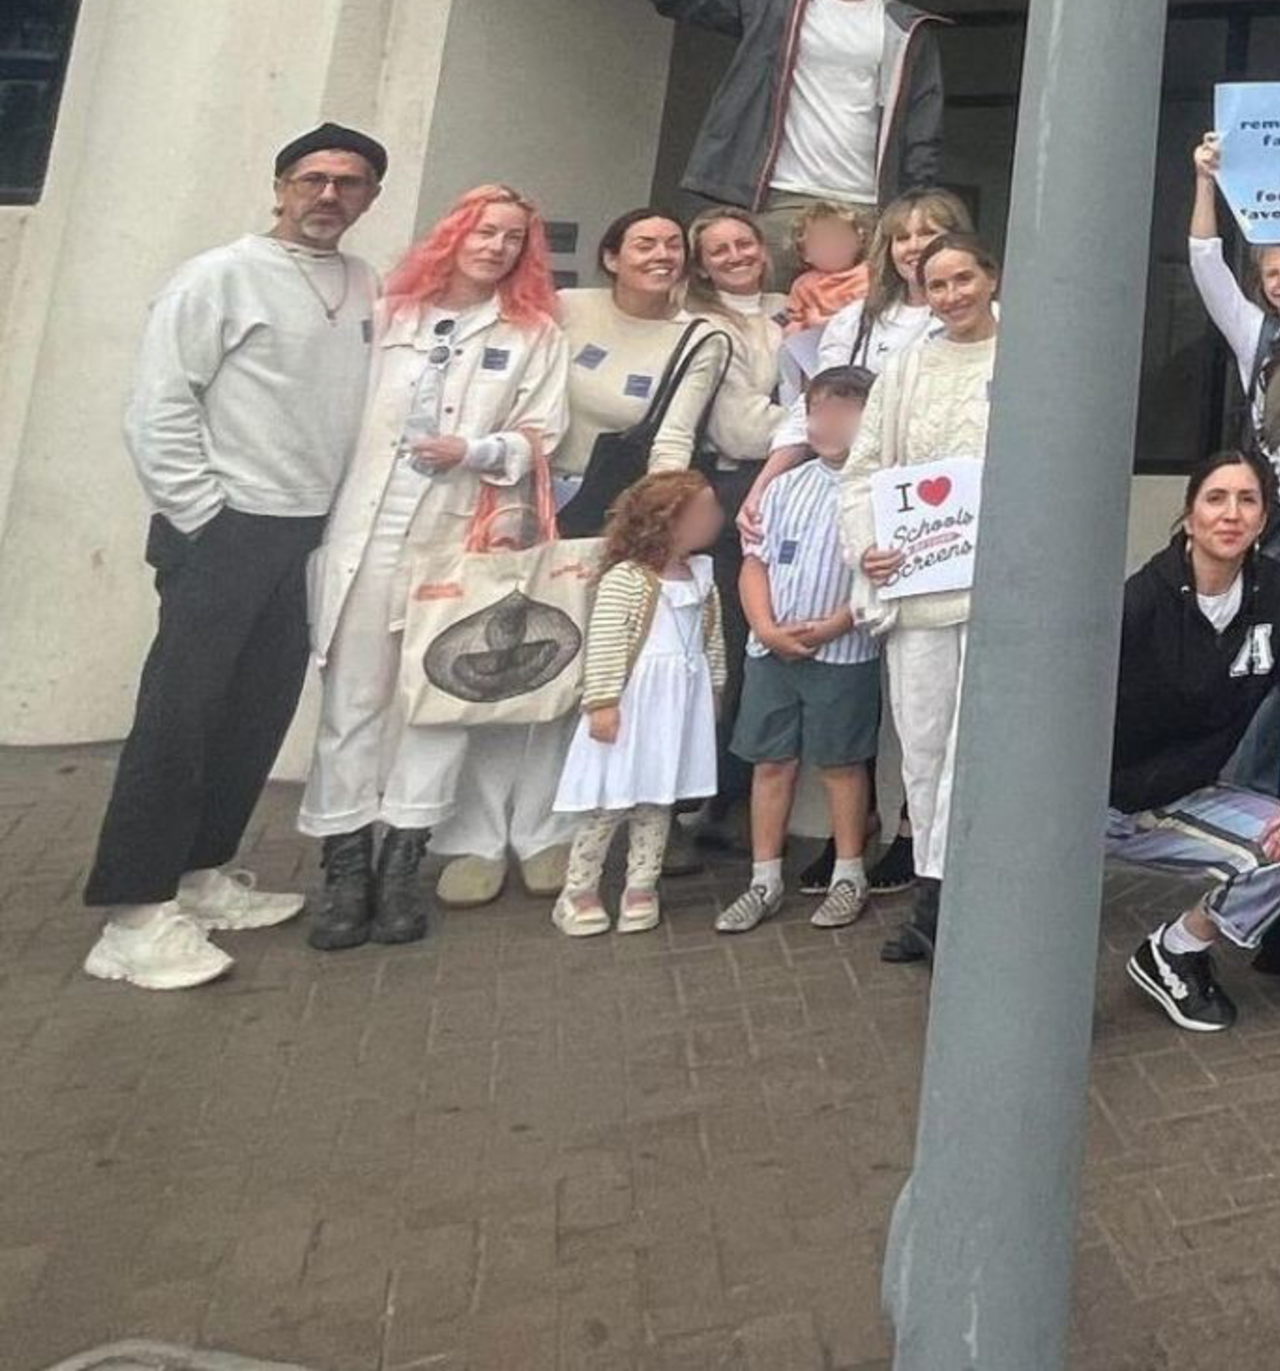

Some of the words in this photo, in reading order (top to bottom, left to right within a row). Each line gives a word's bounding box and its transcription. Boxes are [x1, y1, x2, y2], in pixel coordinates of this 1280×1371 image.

[894, 482, 914, 513] I
[893, 507, 975, 550] Schools
[1230, 622, 1275, 678] A
